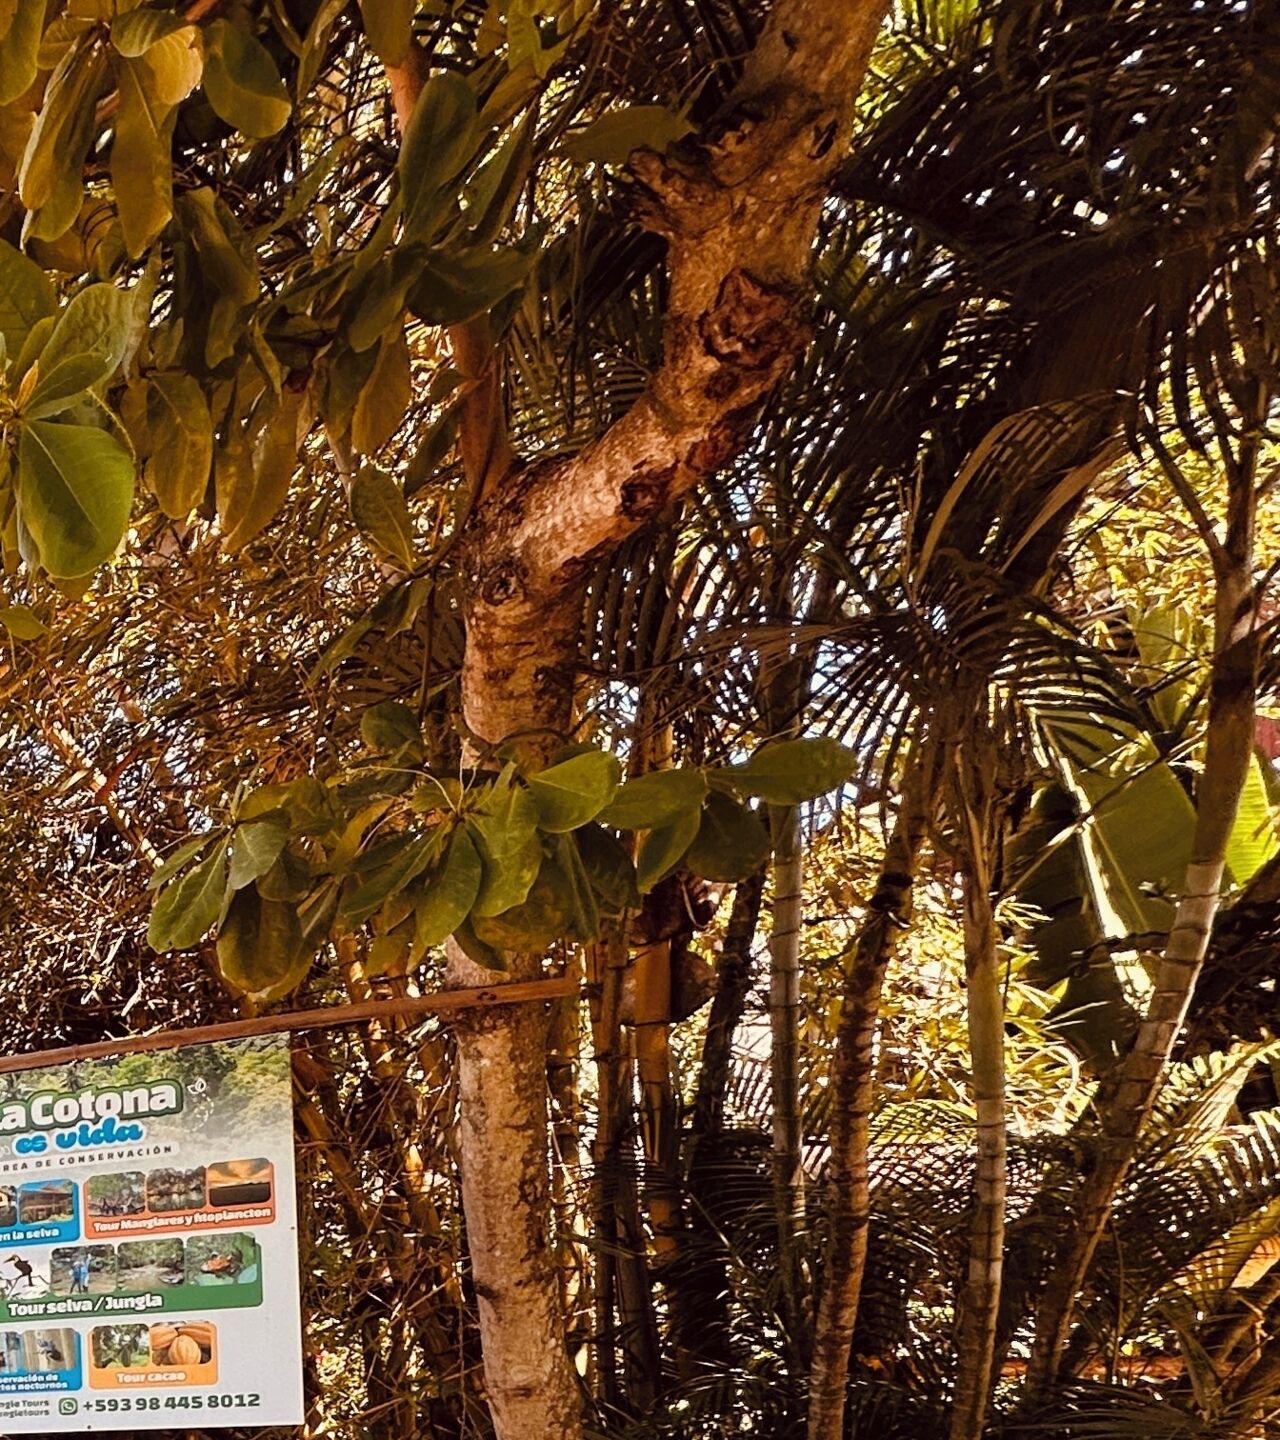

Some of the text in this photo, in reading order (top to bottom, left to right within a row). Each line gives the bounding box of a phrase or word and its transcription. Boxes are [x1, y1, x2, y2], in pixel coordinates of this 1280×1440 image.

[30, 1084, 177, 1126] Cotona
[15, 1116, 143, 1154] es vida
[35, 1158, 52, 1168] DE
[59, 1145, 173, 1166] CONSERVACIÓN
[93, 1221, 120, 1232] Tour
[184, 1215, 193, 1226] y
[12, 1229, 25, 1240] la
[26, 1227, 60, 1239] selva
[8, 1302, 44, 1316] Tour
[46, 1298, 93, 1313] selva
[104, 1293, 163, 1310] Jungla
[45, 1373, 59, 1381] de
[117, 1371, 187, 1383] Tour cacao
[22, 1399, 50, 1407] Tours
[83, 1393, 261, 1412] +593 98 445 8012
